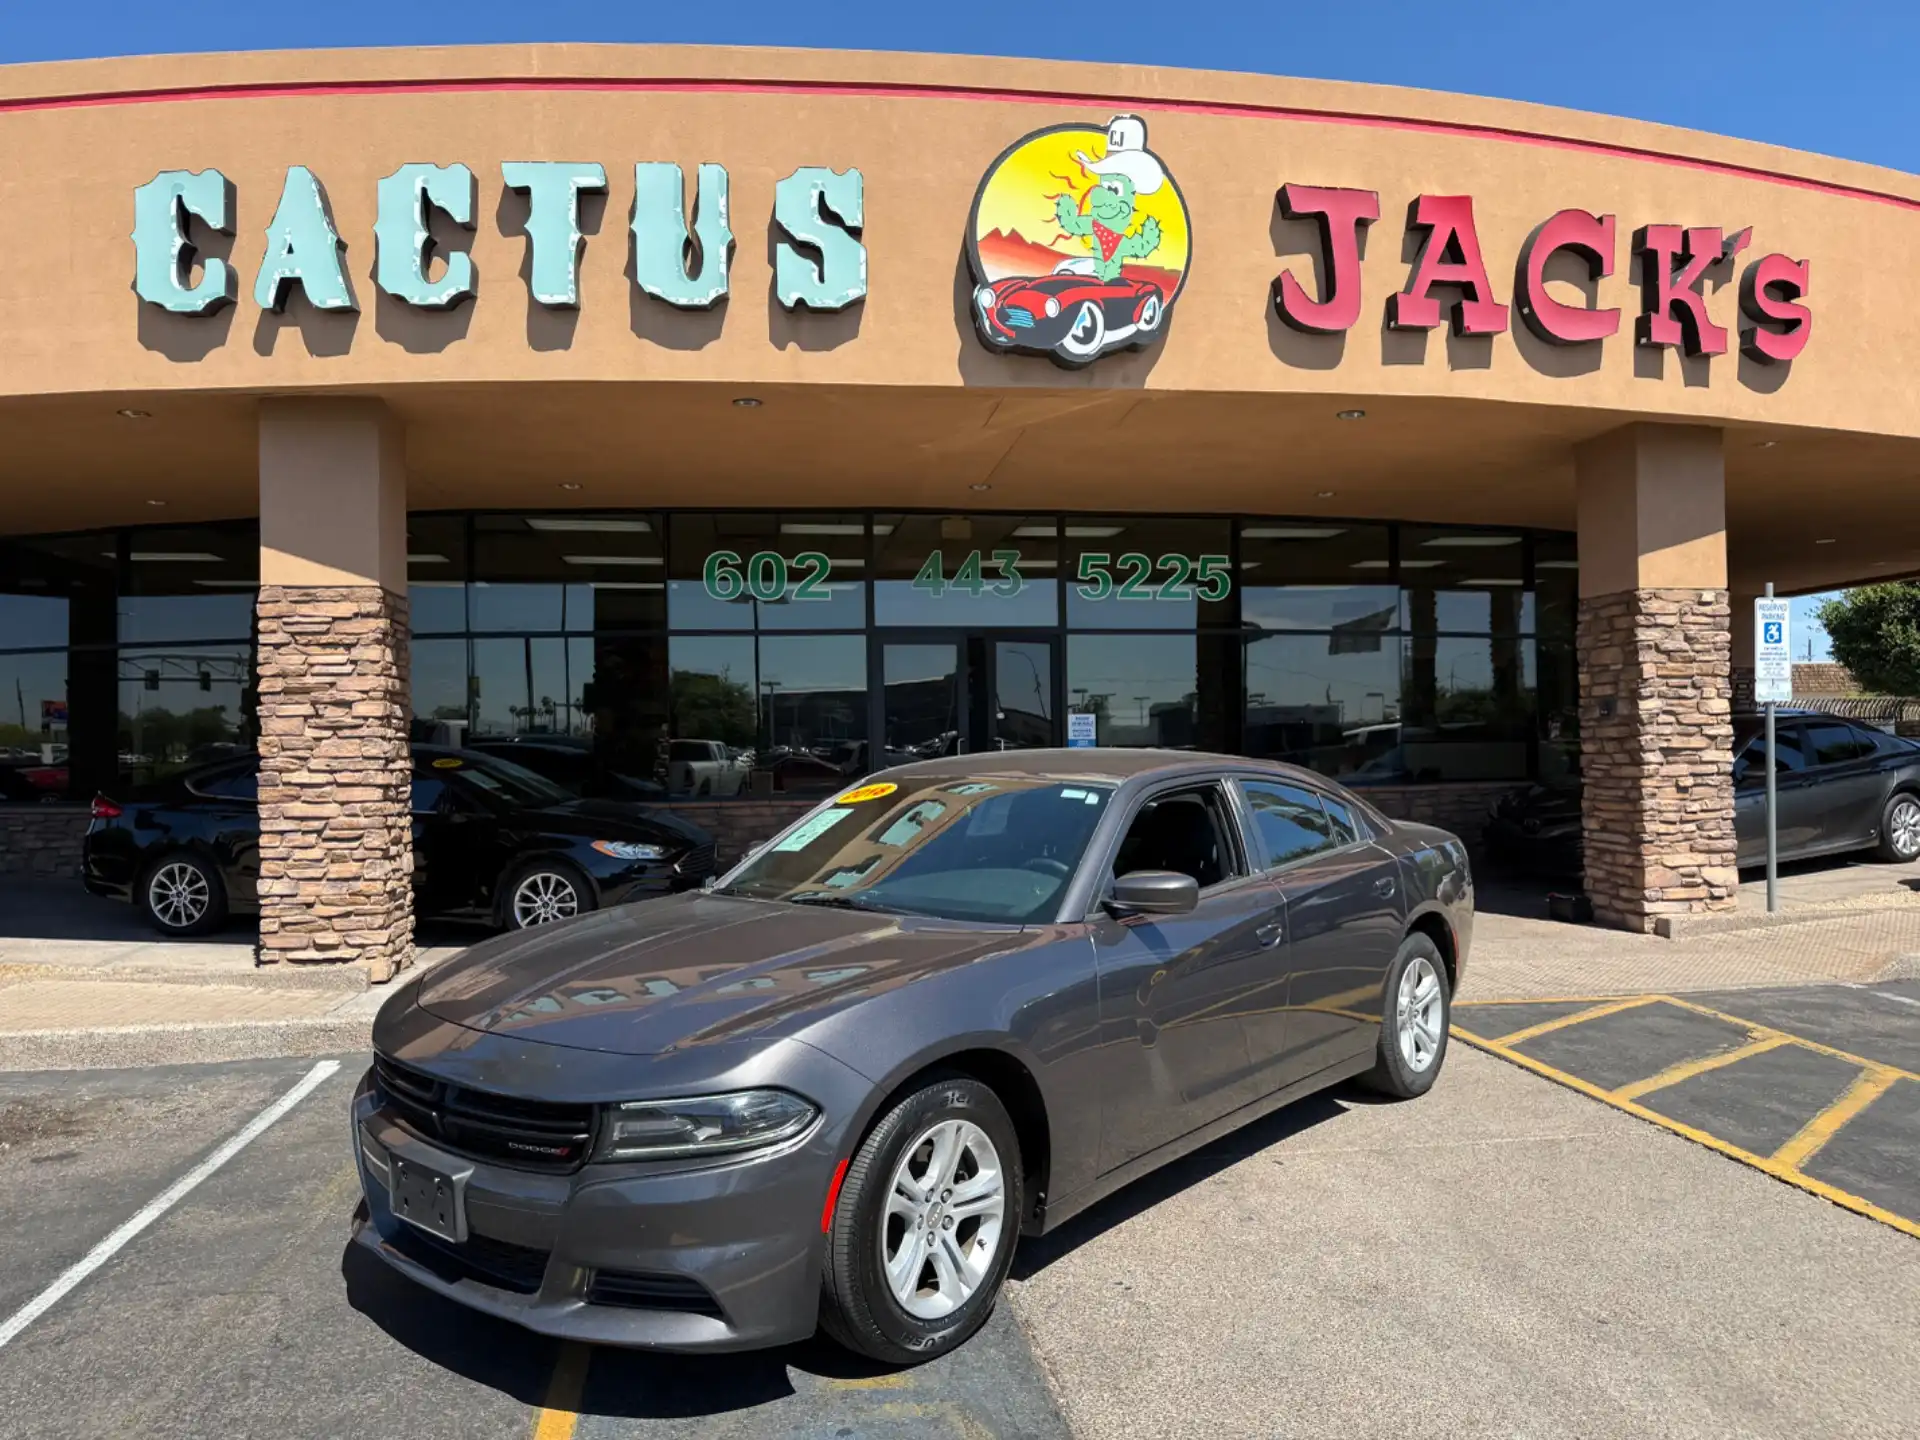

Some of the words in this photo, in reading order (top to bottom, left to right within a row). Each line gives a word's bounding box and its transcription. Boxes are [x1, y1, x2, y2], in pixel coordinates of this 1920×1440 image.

[1109, 129, 1125, 148] CJ
[132, 161, 868, 315] CACTUS
[702, 550, 833, 602] 602
[911, 549, 1025, 599] 443
[1076, 552, 1232, 602] 5225
[508, 1141, 561, 1155] DODGE
